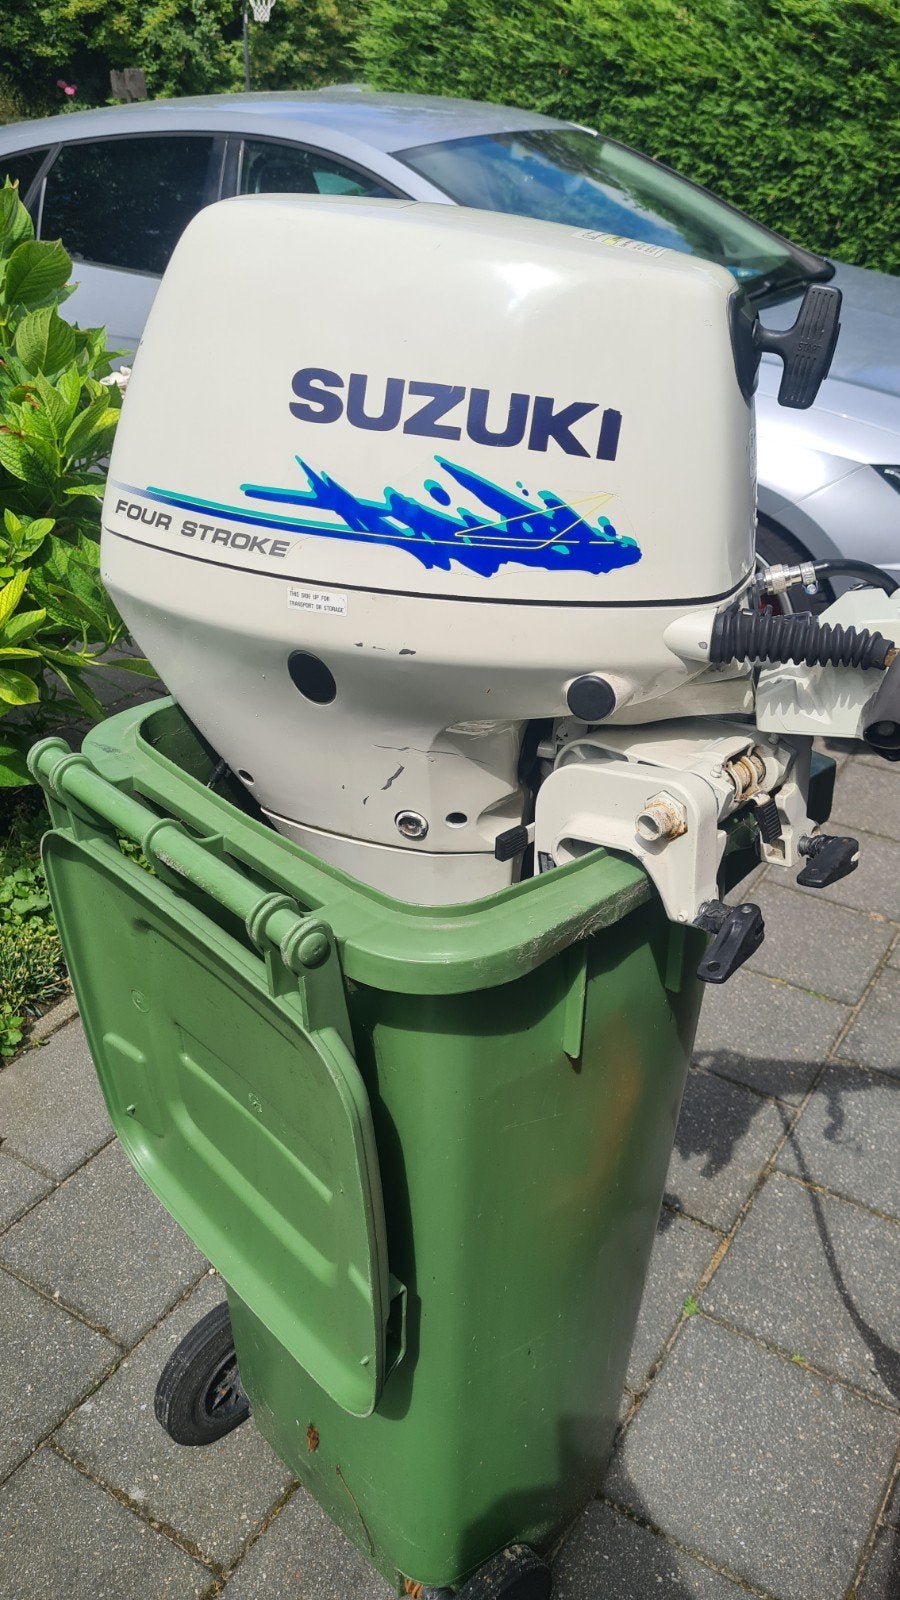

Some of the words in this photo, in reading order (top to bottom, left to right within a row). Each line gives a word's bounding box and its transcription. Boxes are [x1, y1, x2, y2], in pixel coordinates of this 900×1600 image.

[289, 367, 622, 461] SUZUKI
[115, 499, 172, 530] FOUR
[181, 520, 290, 557] STROKE
[289, 590, 299, 598] THIS
[289, 600, 314, 609] TRANSPORT
[324, 605, 344, 613] STORAGE
